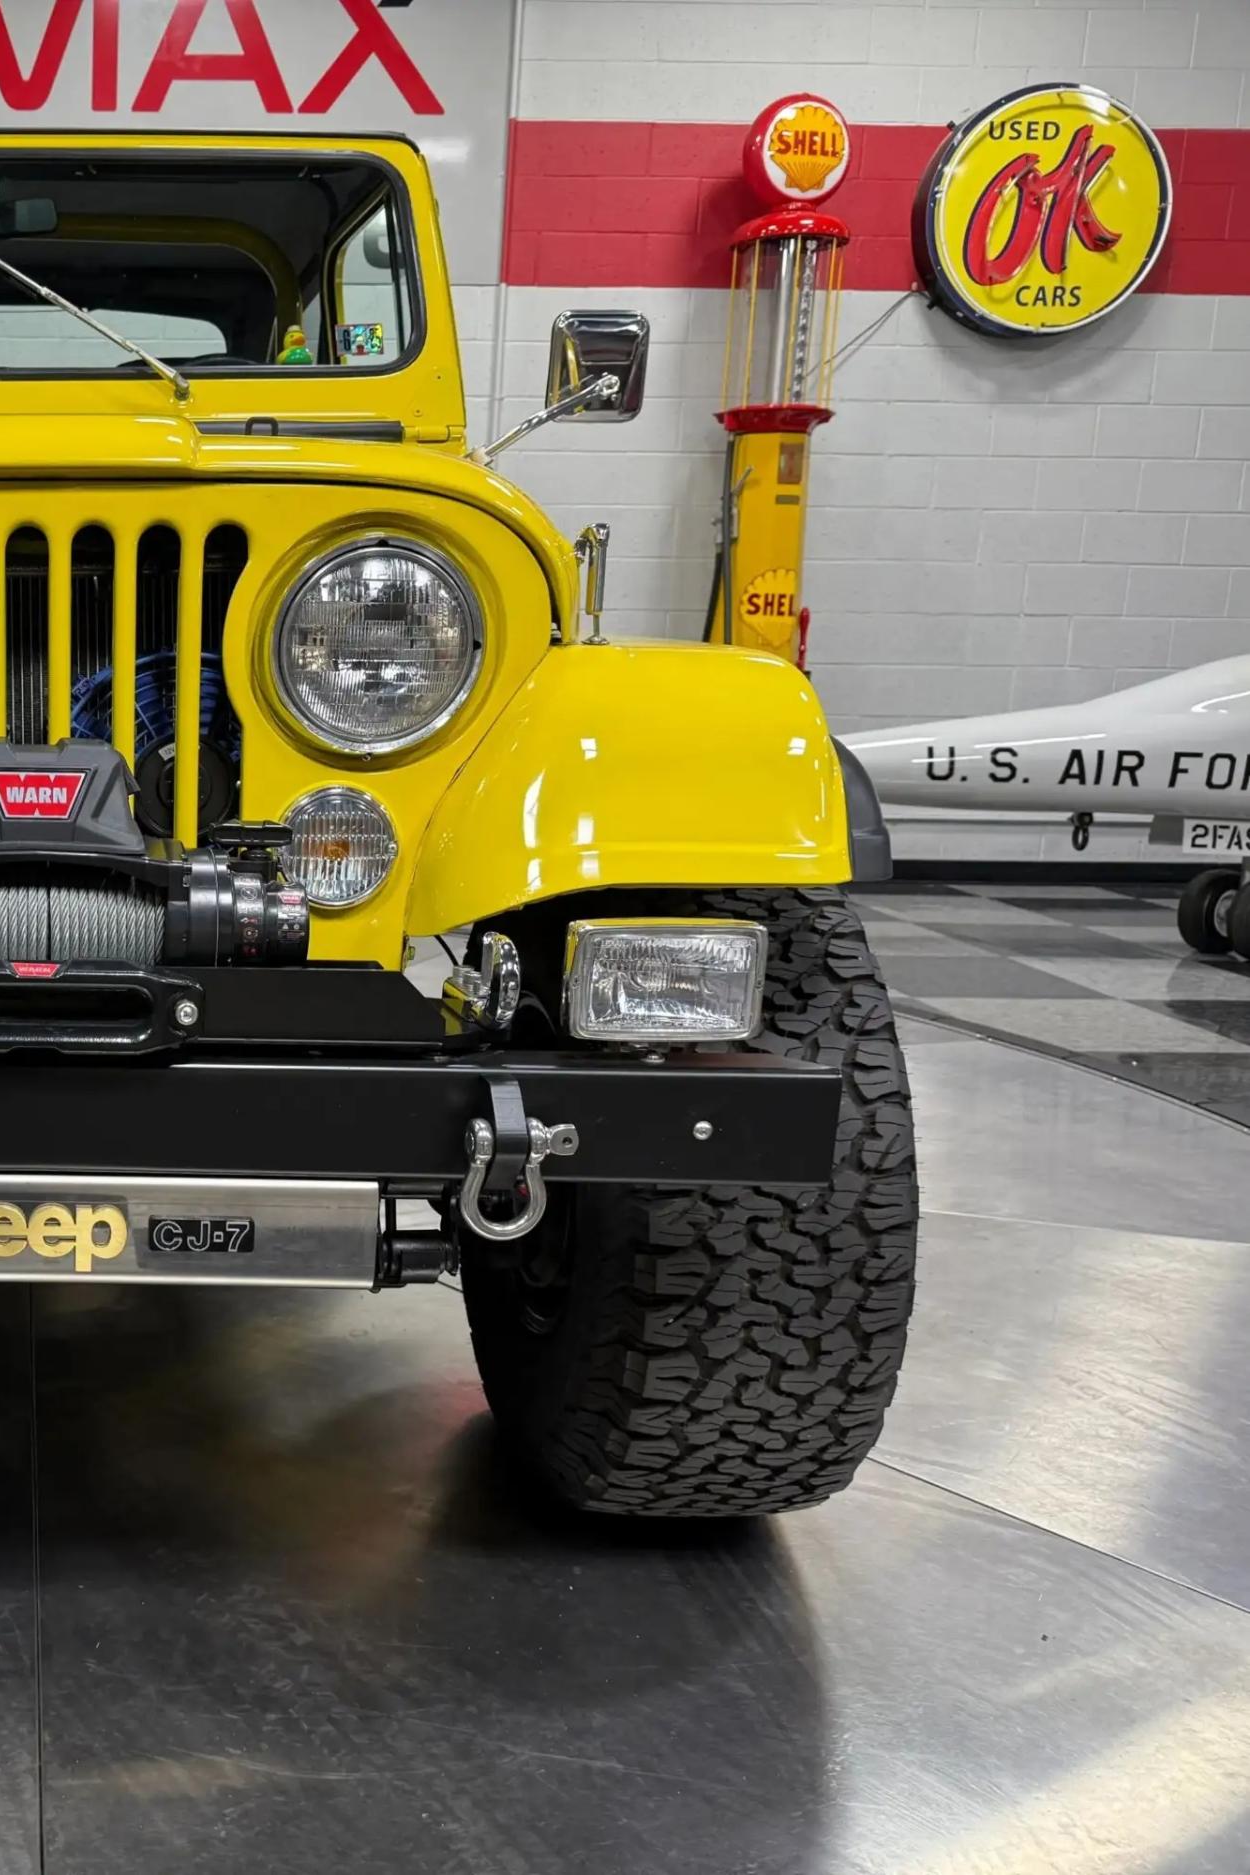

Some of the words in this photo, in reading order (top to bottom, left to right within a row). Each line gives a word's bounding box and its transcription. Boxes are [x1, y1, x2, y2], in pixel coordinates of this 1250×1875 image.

[776, 130, 840, 158] SHELL
[988, 120, 1061, 141] USED
[962, 124, 1123, 286] OK
[1015, 285, 1082, 307] CARS
[1057, 748, 1145, 788] AIR
[1167, 751, 1250, 791] FO
[5, 786, 68, 804] WARN
[1189, 823, 1250, 852] 2FA
